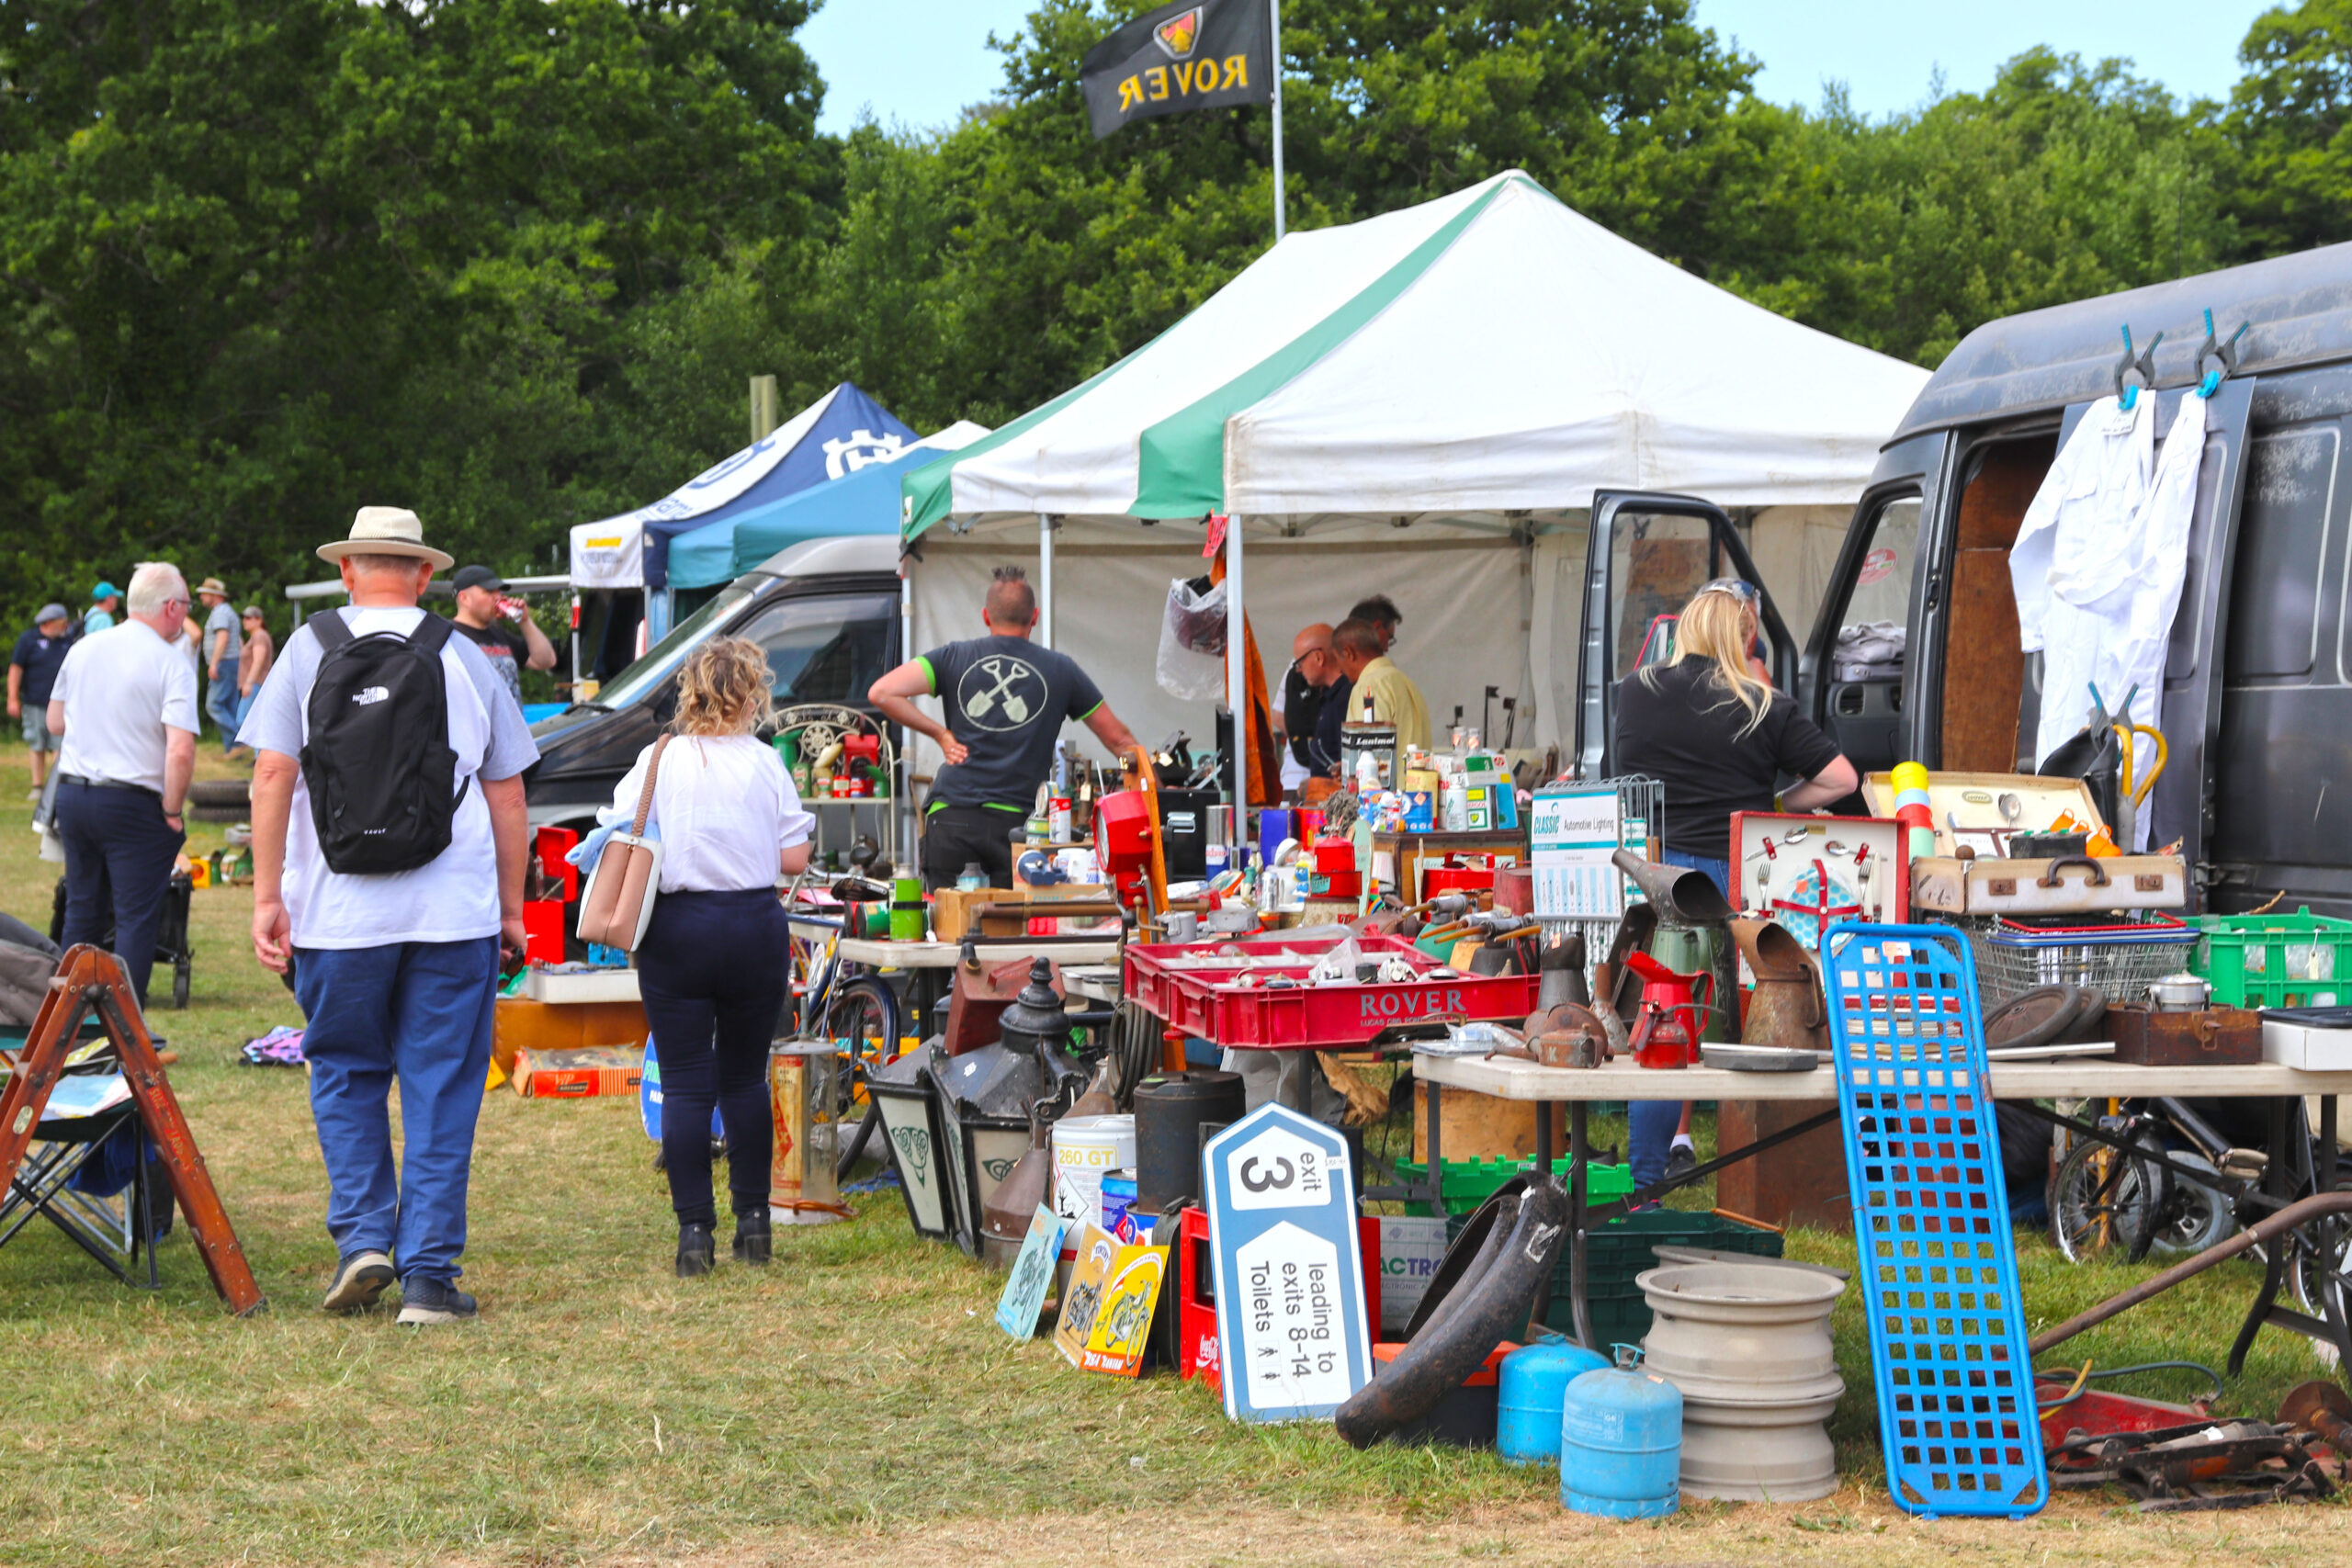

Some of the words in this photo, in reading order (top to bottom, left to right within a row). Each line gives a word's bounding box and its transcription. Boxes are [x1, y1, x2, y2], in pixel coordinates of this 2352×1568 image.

[1534, 815, 1559, 835] CLASSIC
[1564, 818, 1591, 831] Automotive
[1593, 817, 1614, 833] Lighting
[1360, 989, 1466, 1017] ROVER
[1058, 1149, 1083, 1166] 260
[1088, 1150, 1114, 1166] GT
[1240, 1156, 1295, 1193] 3
[1300, 1152, 1322, 1191] exit
[1250, 1260, 1274, 1333] Toilets
[1282, 1261, 1305, 1315] exits
[1308, 1263, 1332, 1340] leading
[1288, 1327, 1312, 1378] 8-14
[1317, 1350, 1337, 1373] to
